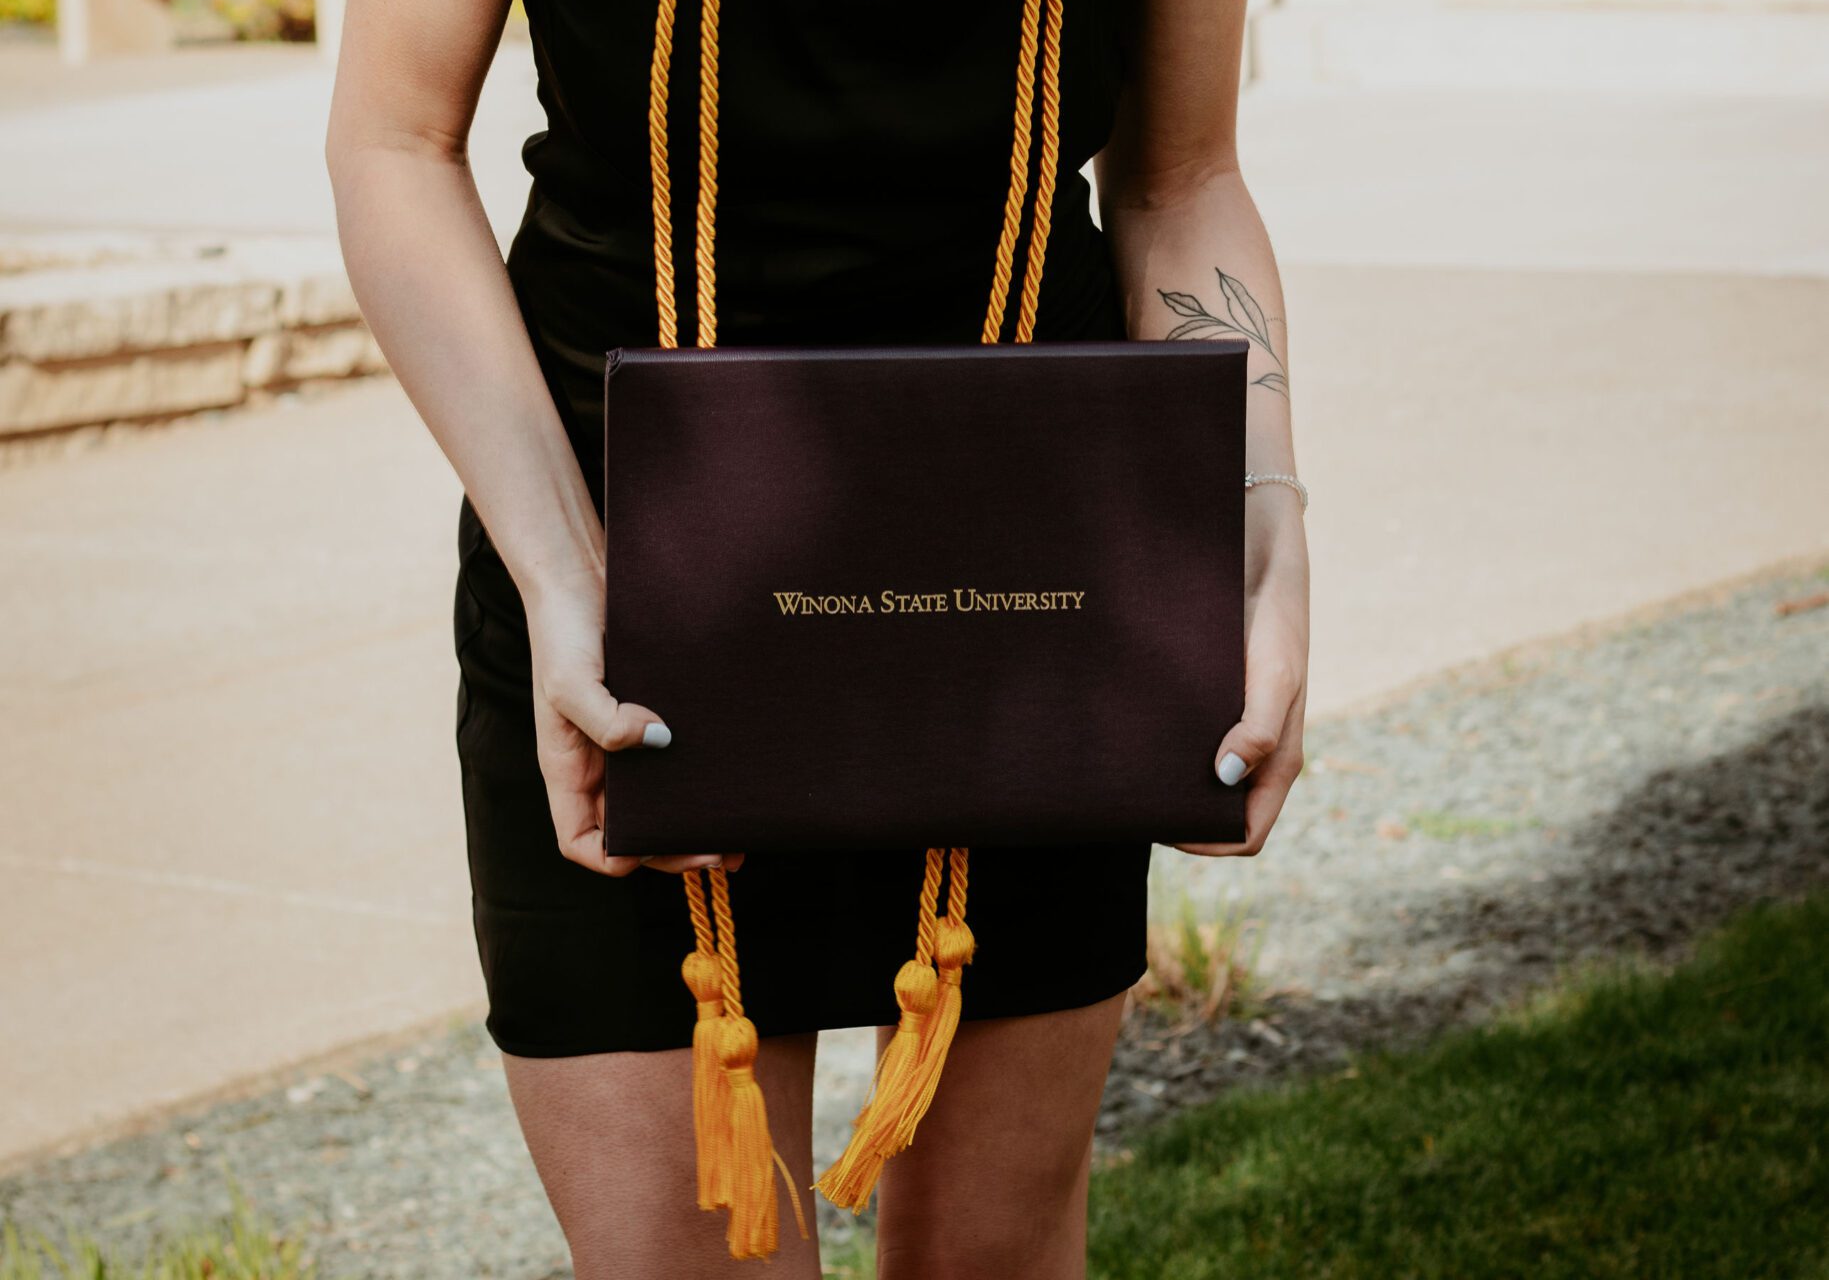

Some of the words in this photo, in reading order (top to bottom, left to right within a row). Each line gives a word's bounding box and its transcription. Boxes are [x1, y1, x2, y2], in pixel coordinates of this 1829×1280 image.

[773, 591, 874, 616] WINONA
[880, 589, 948, 613] STATE
[953, 588, 1085, 612] UNIVERSITY
